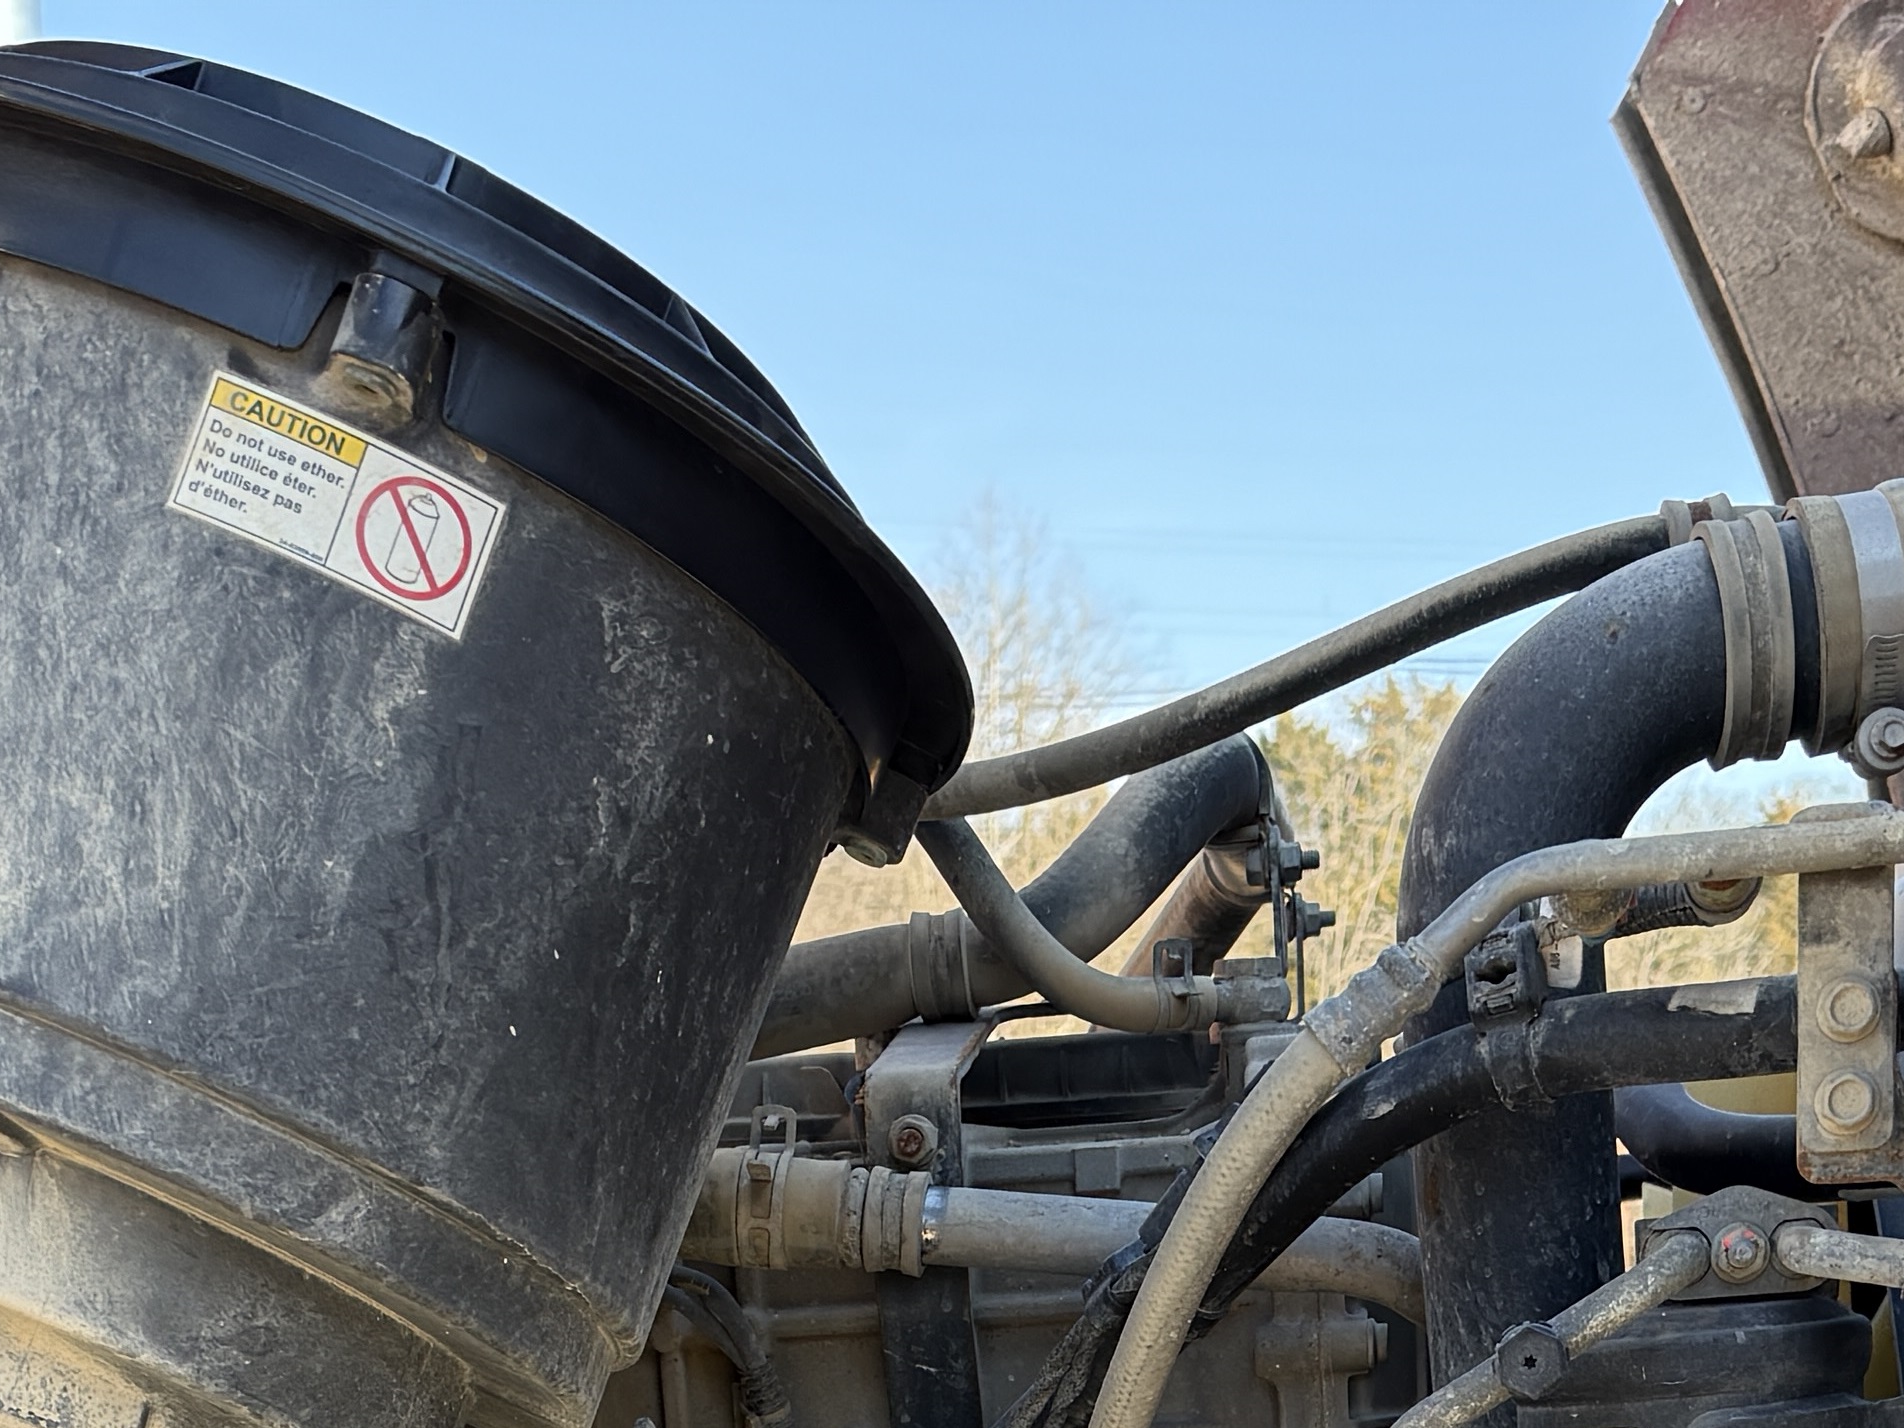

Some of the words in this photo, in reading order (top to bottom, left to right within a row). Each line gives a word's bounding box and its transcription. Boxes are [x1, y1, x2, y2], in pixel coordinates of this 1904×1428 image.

[210, 419, 233, 438] Do
[236, 433, 264, 452] not
[267, 446, 296, 466] use
[301, 461, 345, 489] ether.
[230, 392, 345, 456] CAUTION
[188, 480, 248, 513] d'éther.
[196, 458, 270, 500] N'utilisez
[273, 493, 302, 514] pas
[203, 438, 225, 458] No
[229, 452, 278, 480] utilice
[283, 473, 317, 498] éter.
